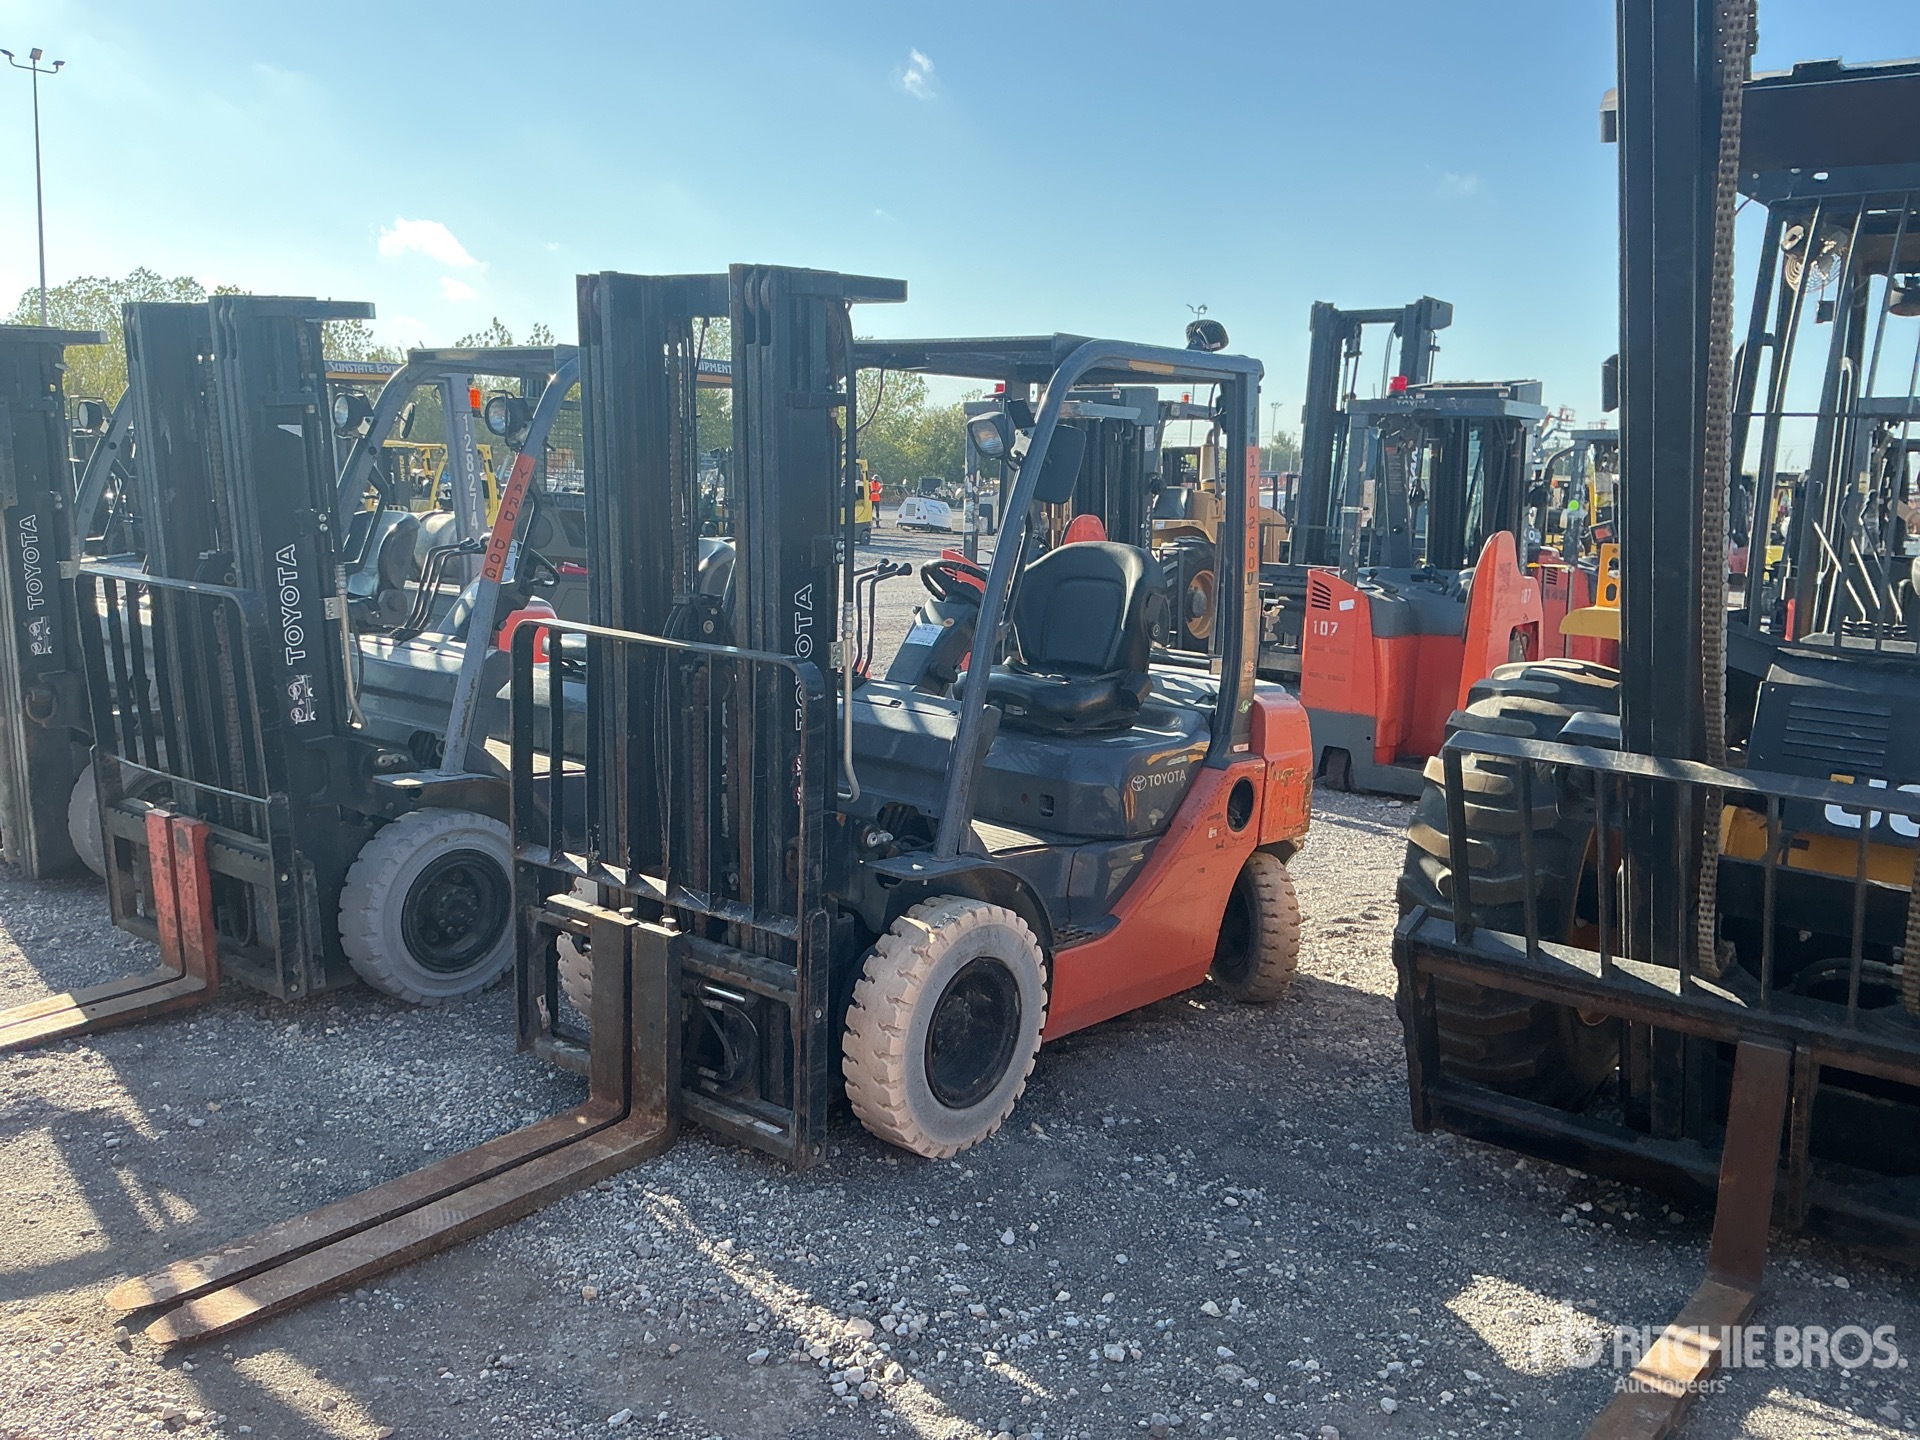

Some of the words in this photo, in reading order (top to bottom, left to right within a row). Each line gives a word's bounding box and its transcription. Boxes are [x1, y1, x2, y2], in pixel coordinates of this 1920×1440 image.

[328, 361, 374, 374] SUNSTATE
[462, 413, 479, 530] 128274
[504, 468, 529, 522] YARD
[19, 514, 45, 610] TOYOTA
[484, 538, 506, 579] DOG
[275, 543, 306, 666] TOYOTA
[1313, 620, 1339, 637] 107
[1147, 769, 1187, 787] TOYOTA
